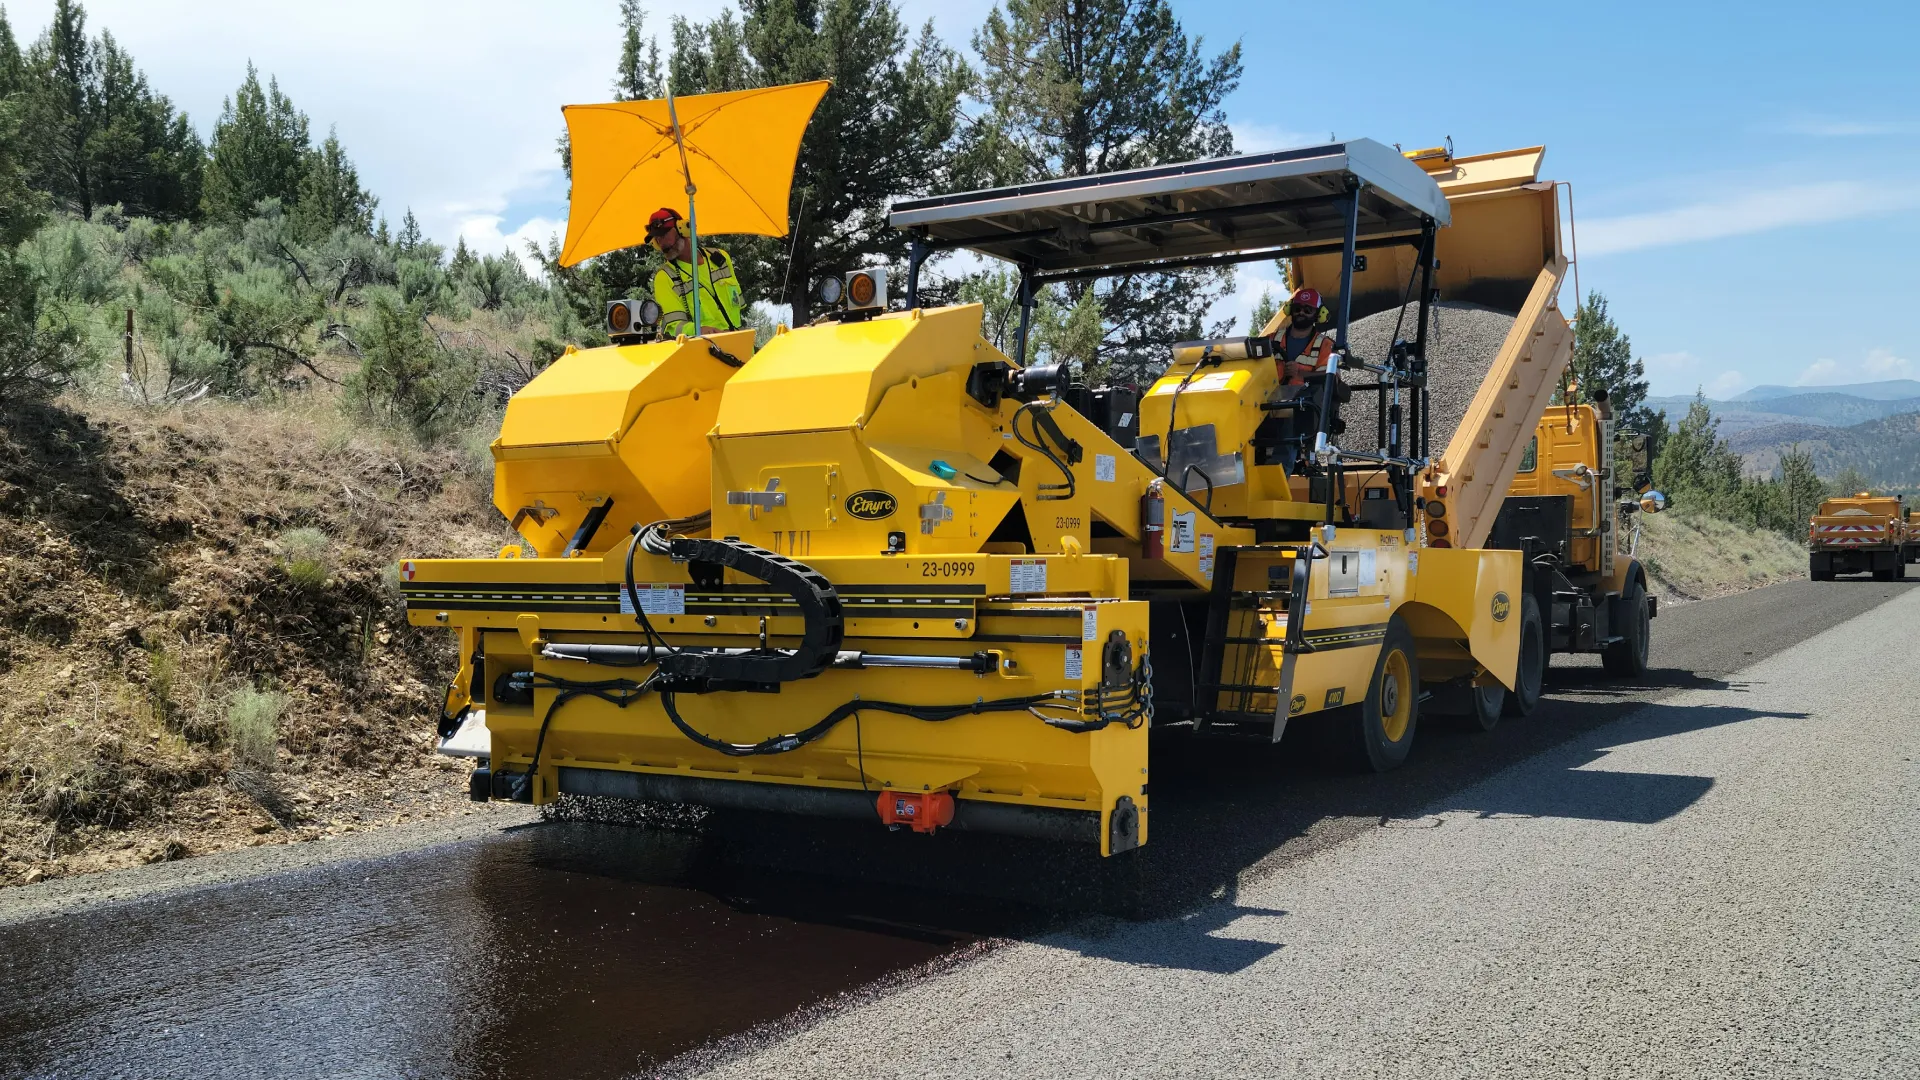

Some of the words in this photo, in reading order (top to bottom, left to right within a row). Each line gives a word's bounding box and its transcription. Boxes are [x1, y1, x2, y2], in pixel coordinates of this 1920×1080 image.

[851, 496, 892, 515] Etnyre
[1055, 516, 1081, 529] 23-0999
[922, 561, 975, 577] 23-0999
